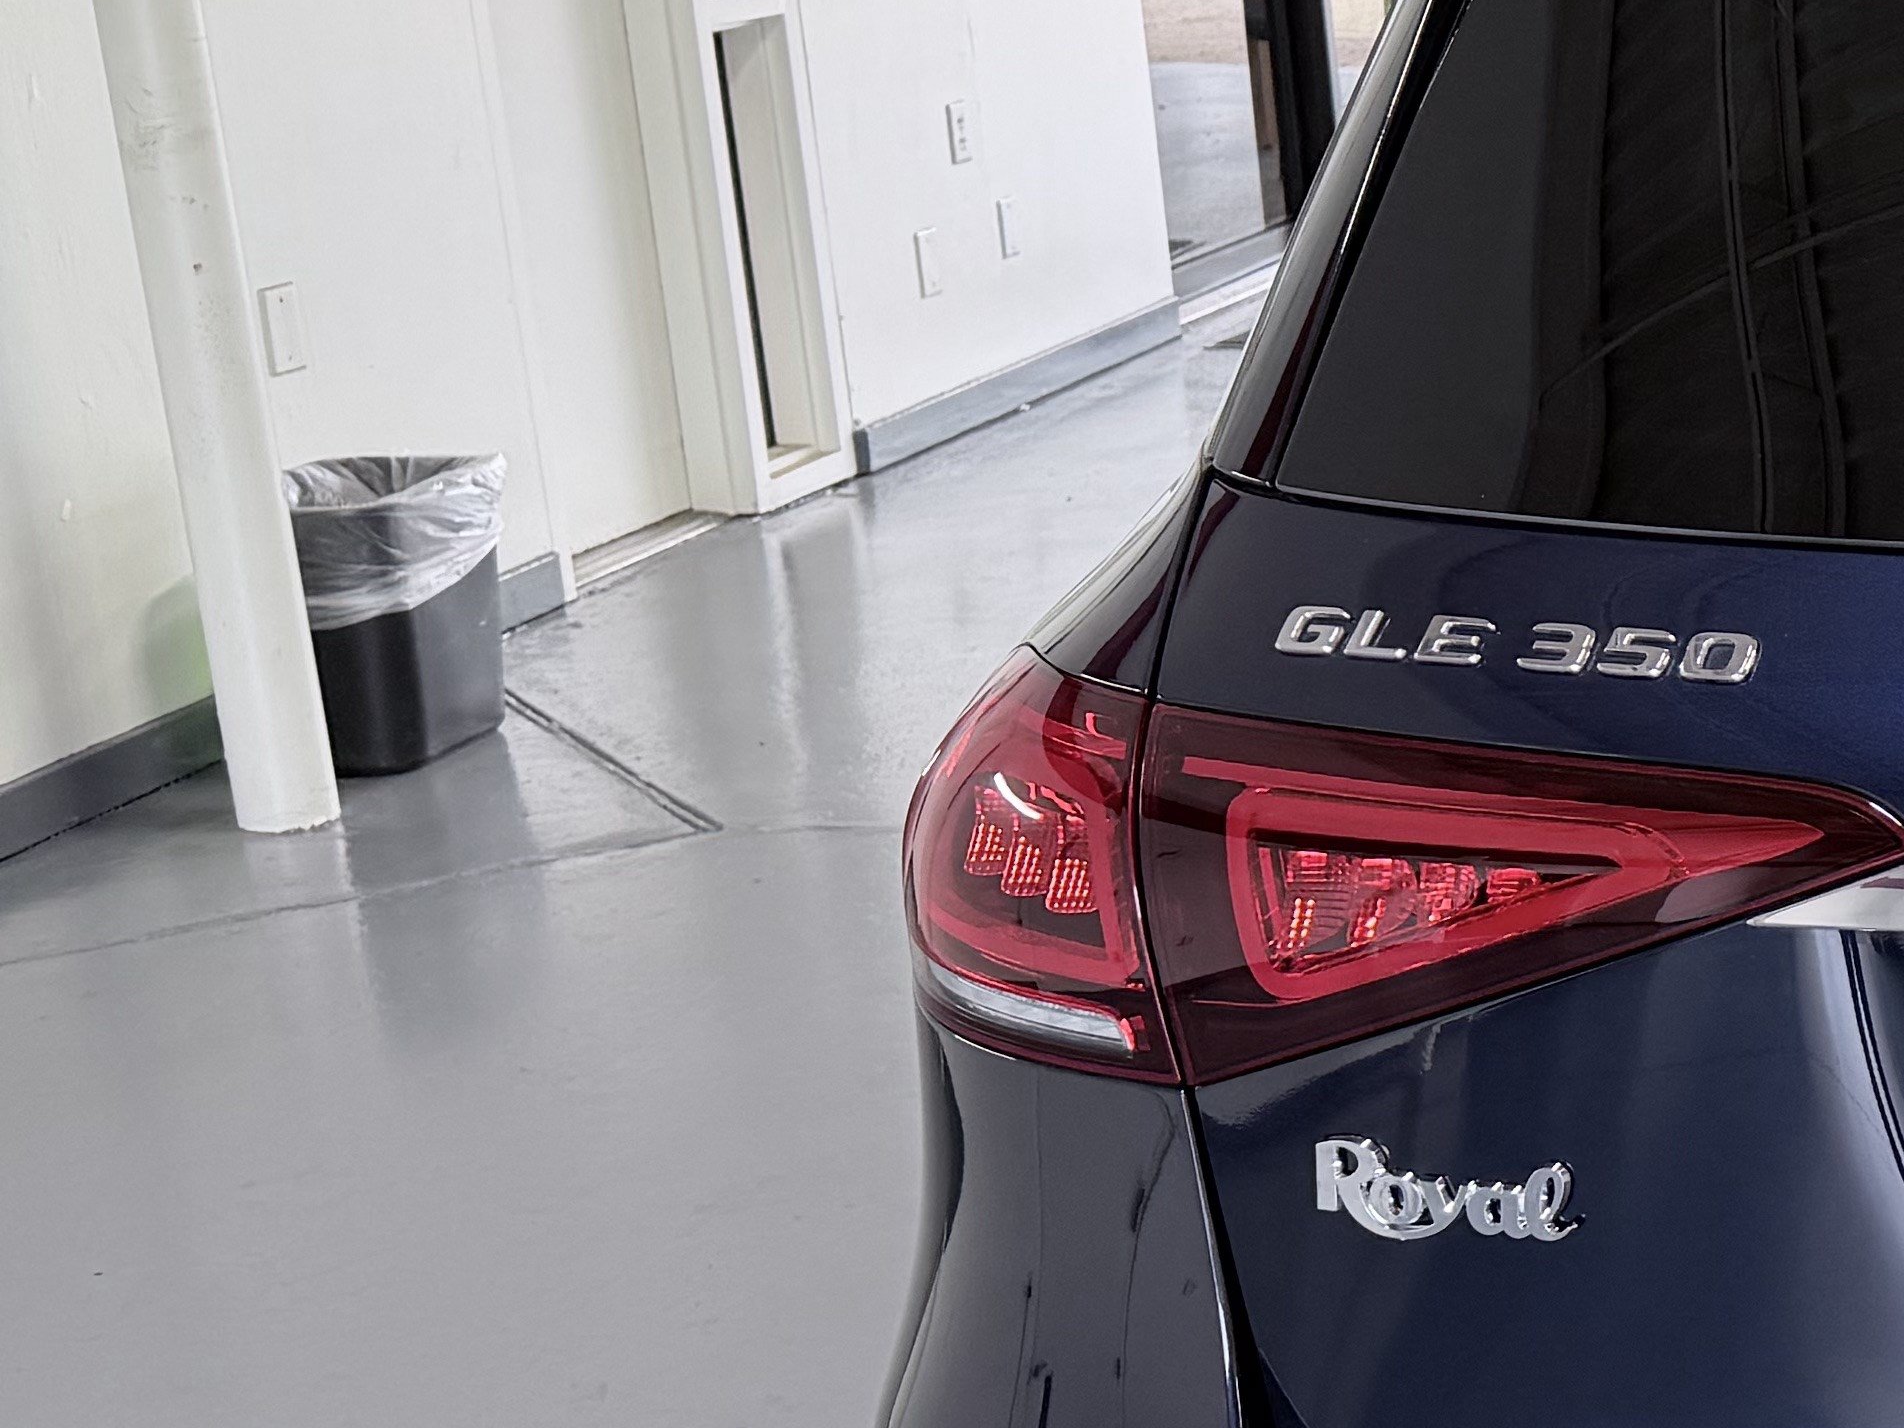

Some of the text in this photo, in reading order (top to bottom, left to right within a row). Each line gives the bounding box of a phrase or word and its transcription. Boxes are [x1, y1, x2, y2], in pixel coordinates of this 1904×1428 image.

[1274, 604, 1761, 685] GLE 350
[1315, 1135, 1586, 1242] Royal
